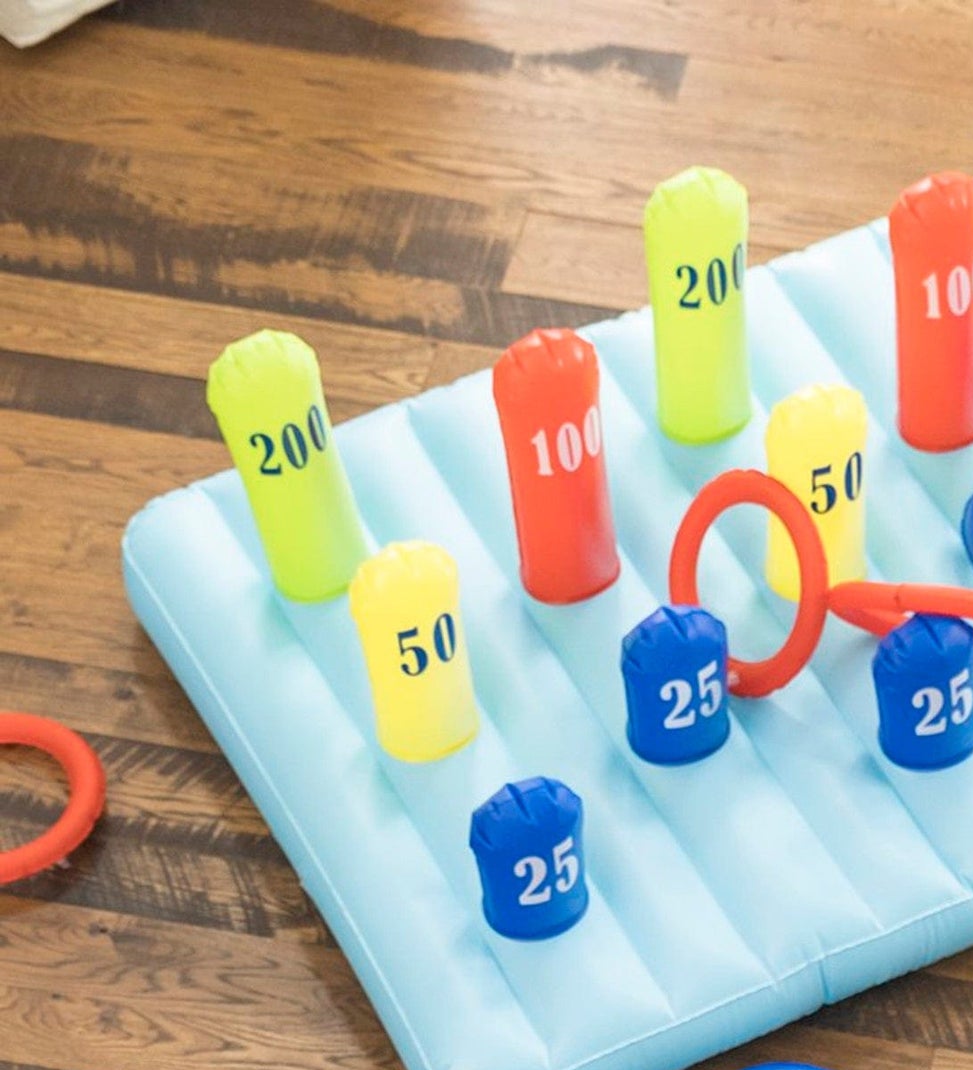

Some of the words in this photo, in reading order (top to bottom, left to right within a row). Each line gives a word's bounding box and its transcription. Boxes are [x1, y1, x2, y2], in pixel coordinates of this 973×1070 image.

[249, 404, 326, 476] 200
[530, 405, 600, 476] 100
[810, 452, 862, 515] 50
[397, 613, 456, 676] 50
[659, 660, 722, 730] 25
[910, 668, 973, 737] 25
[512, 837, 580, 906] 25
